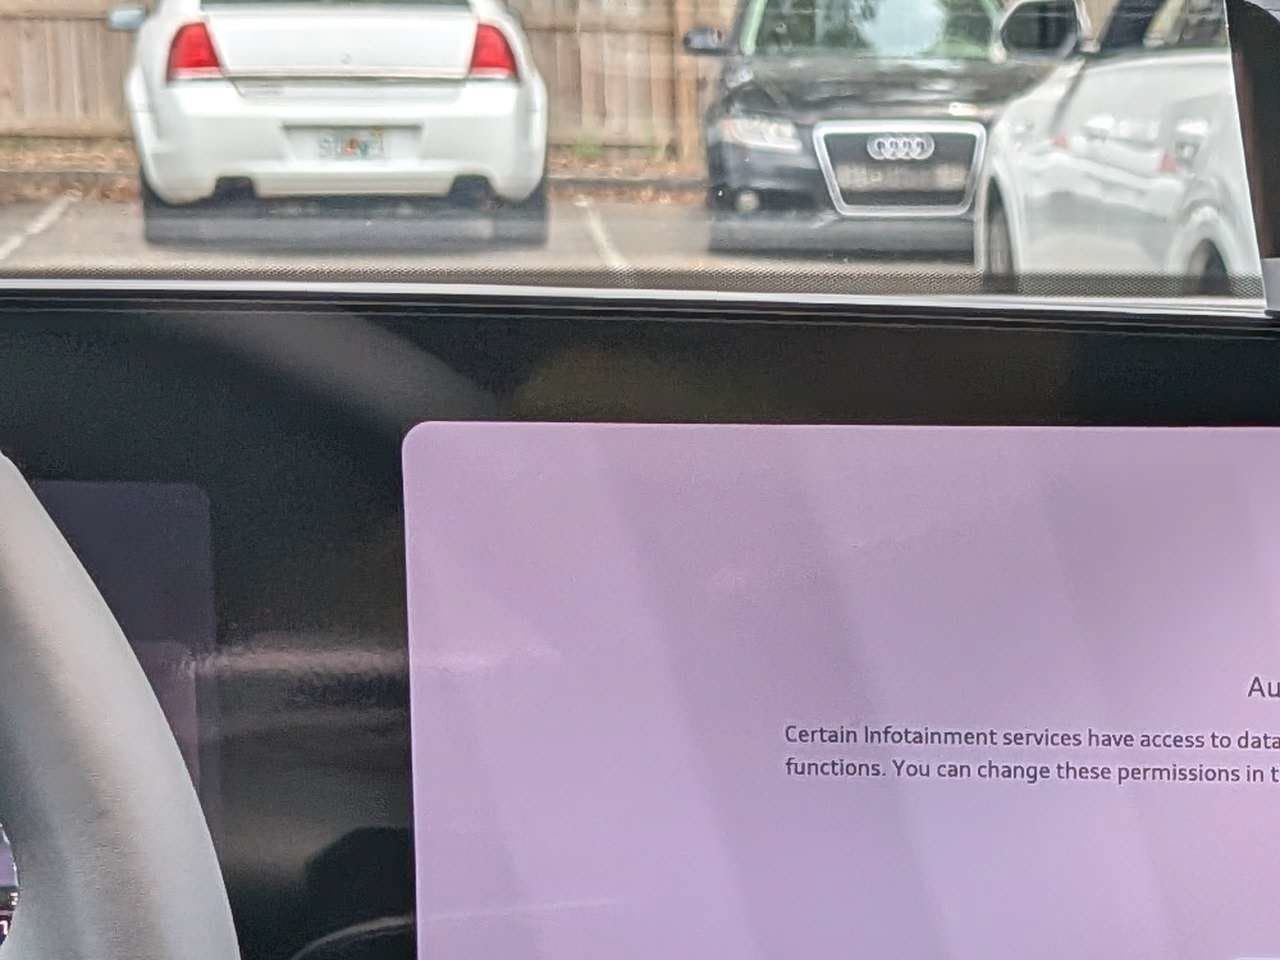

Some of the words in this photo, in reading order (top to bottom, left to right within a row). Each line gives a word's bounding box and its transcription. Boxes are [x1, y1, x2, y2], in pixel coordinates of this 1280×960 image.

[784, 724, 858, 745] Certain
[863, 725, 998, 747] Infotainment
[1002, 728, 1082, 749] services
[1087, 728, 1135, 749] have
[1139, 732, 1205, 750] access
[1210, 731, 1232, 750] to
[784, 757, 887, 778] functions.
[892, 760, 931, 779] You
[936, 763, 972, 780] can
[977, 760, 1051, 785] change
[1055, 760, 1113, 781] these
[1117, 762, 1241, 786] permissions
[1246, 764, 1265, 783] in
